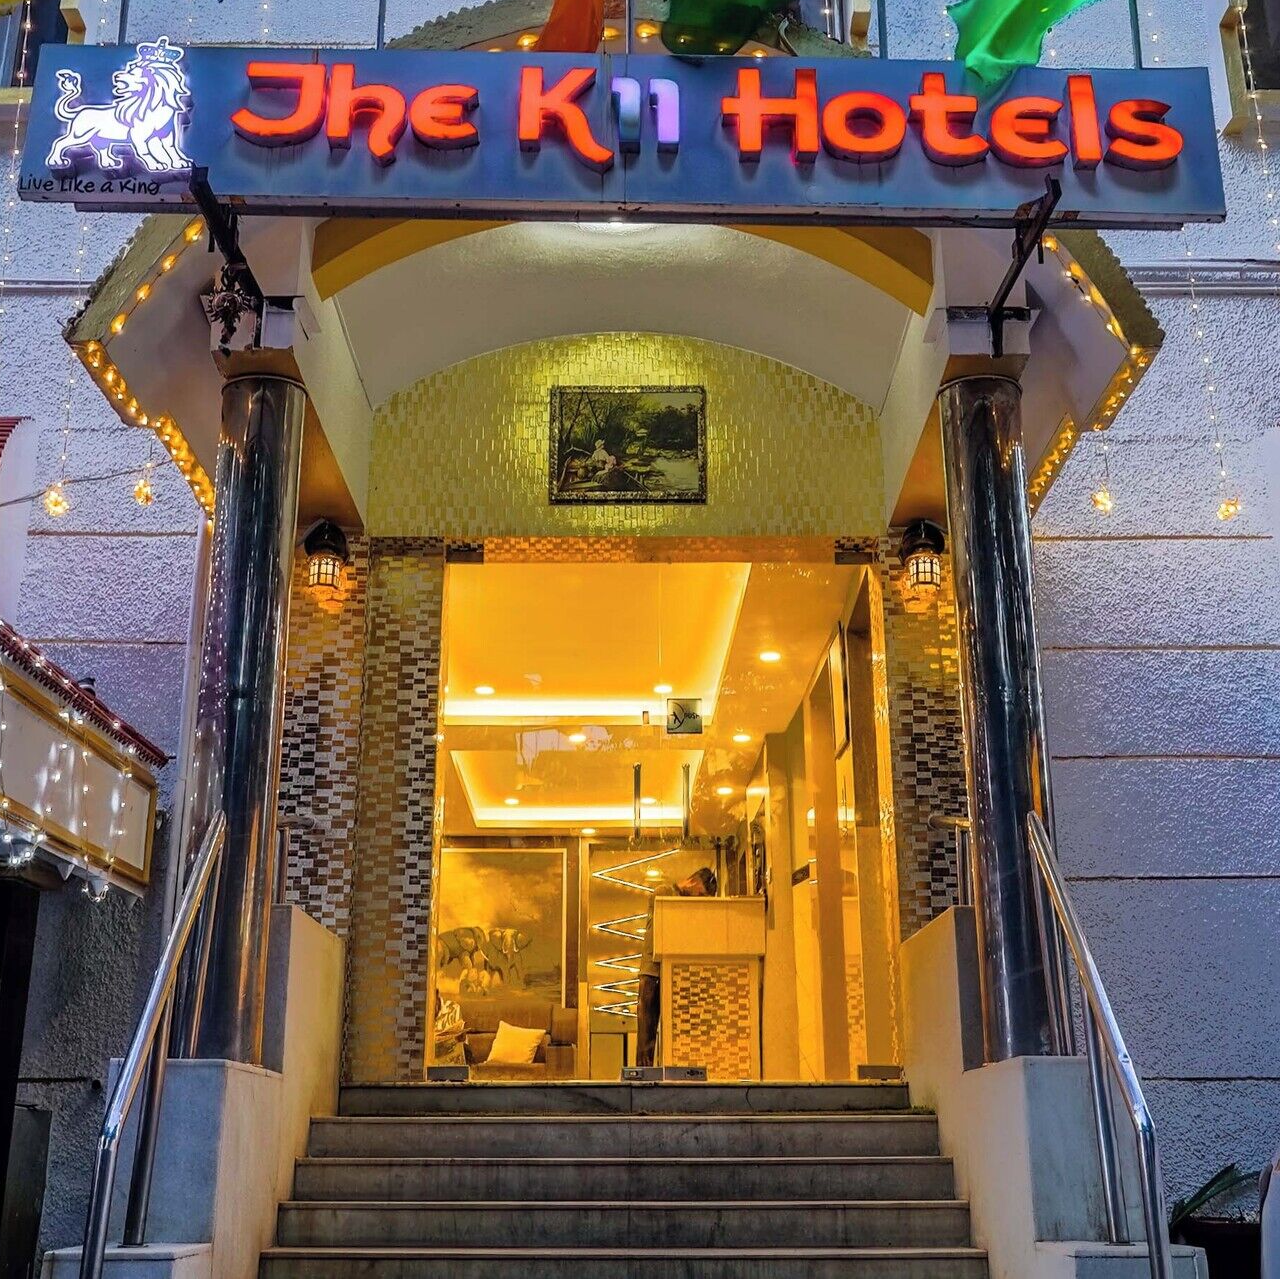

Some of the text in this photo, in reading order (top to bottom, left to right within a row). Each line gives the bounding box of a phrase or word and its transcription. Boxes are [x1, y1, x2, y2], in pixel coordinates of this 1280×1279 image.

[720, 67, 1186, 170] Hotels
[19, 176, 161, 196] Live Like a King
